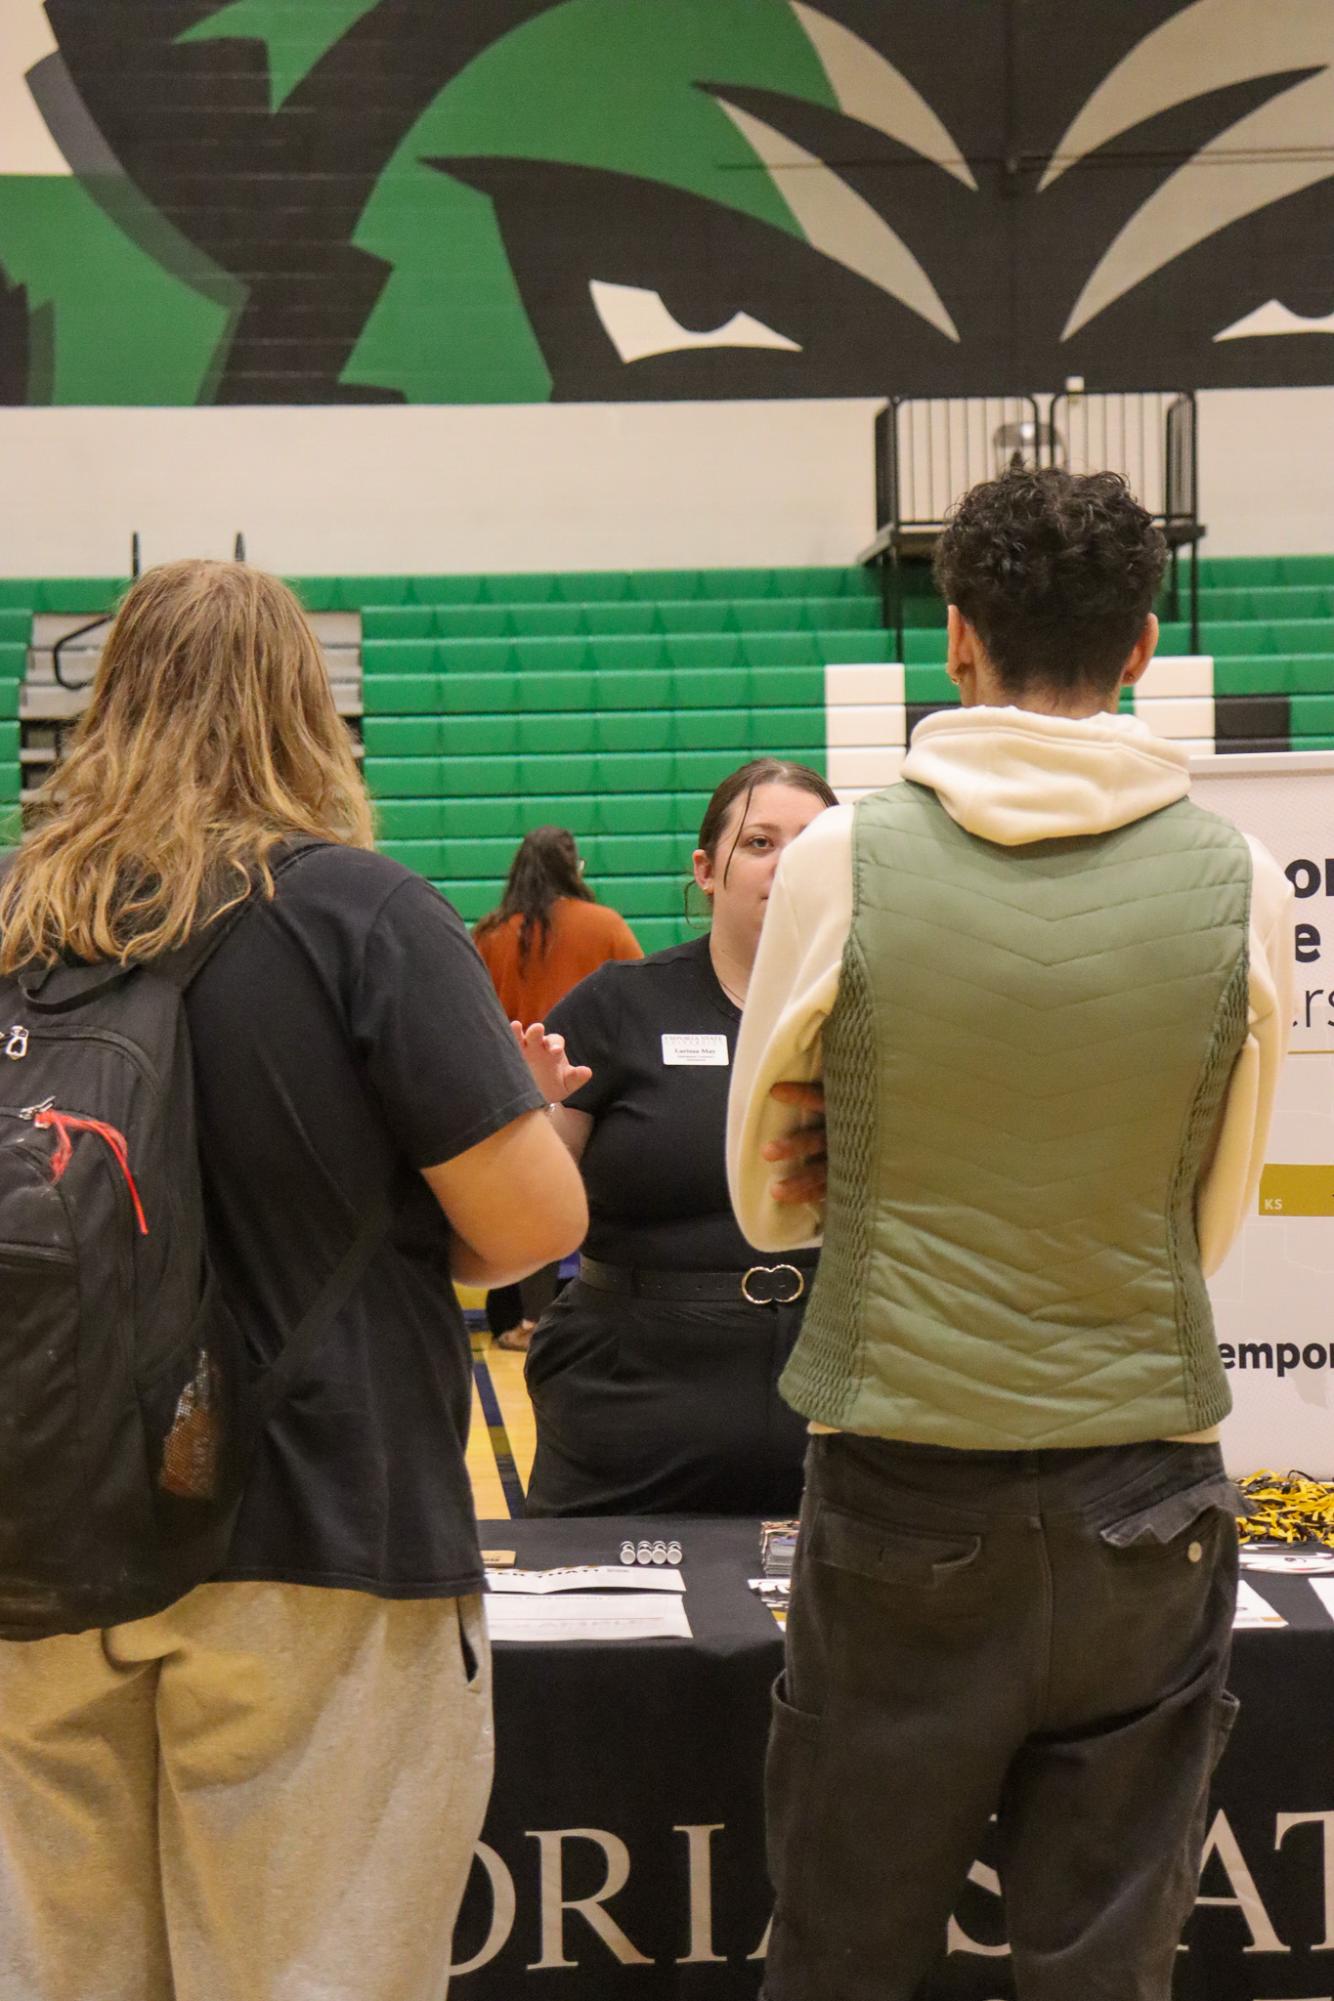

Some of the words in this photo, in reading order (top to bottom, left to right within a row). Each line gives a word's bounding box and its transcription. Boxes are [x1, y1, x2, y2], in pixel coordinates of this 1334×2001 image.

[1284, 858, 1334, 899] o
[1294, 923, 1321, 963] e
[1264, 1199, 1283, 1210] KS
[1218, 1342, 1334, 1377] empo
[449, 1823, 775, 1977] RI
